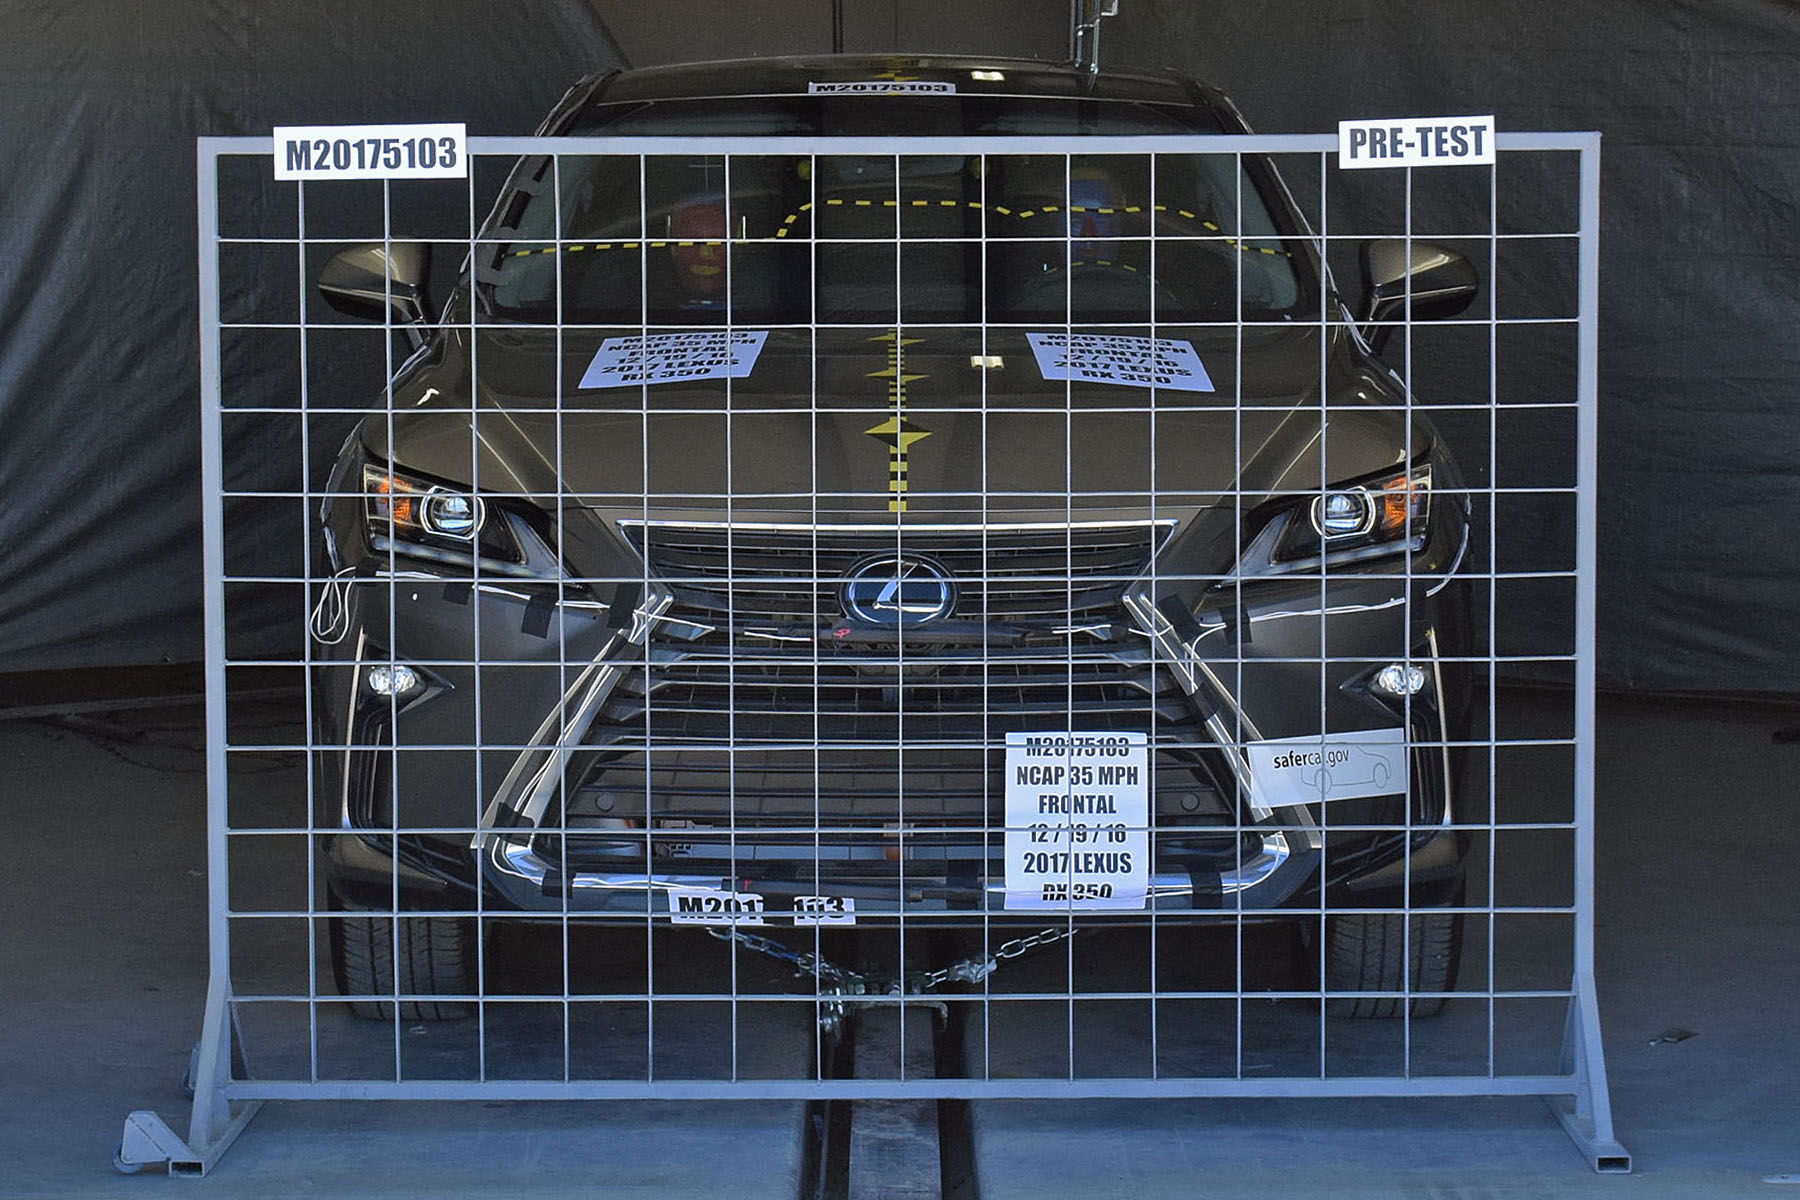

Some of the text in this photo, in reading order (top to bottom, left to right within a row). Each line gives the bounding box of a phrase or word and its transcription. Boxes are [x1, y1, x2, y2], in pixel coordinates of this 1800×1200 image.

[816, 84, 948, 92] M20175103
[1350, 125, 1487, 159] PRE-TEST
[286, 137, 457, 171] M20175103
[608, 343, 667, 352] NCAP
[1103, 342, 1133, 350] 35
[601, 359, 740, 373] 2017 LEXUS
[621, 368, 711, 381] RX 350
[1053, 360, 1192, 376] 2017 LEXUS
[1082, 370, 1171, 383] RX 350
[1025, 737, 1129, 757] M20175103
[1273, 750, 1349, 769] saferca.gov
[1017, 766, 1138, 785] NCAP 35 MPH
[1039, 795, 1116, 814] FRONTAL
[1028, 823, 1048, 842] 12
[1066, 823, 1087, 843] 19
[1106, 823, 1126, 843] 16
[1023, 852, 1132, 873] 2017 LEXUS
[1042, 883, 1112, 901] RX 350
